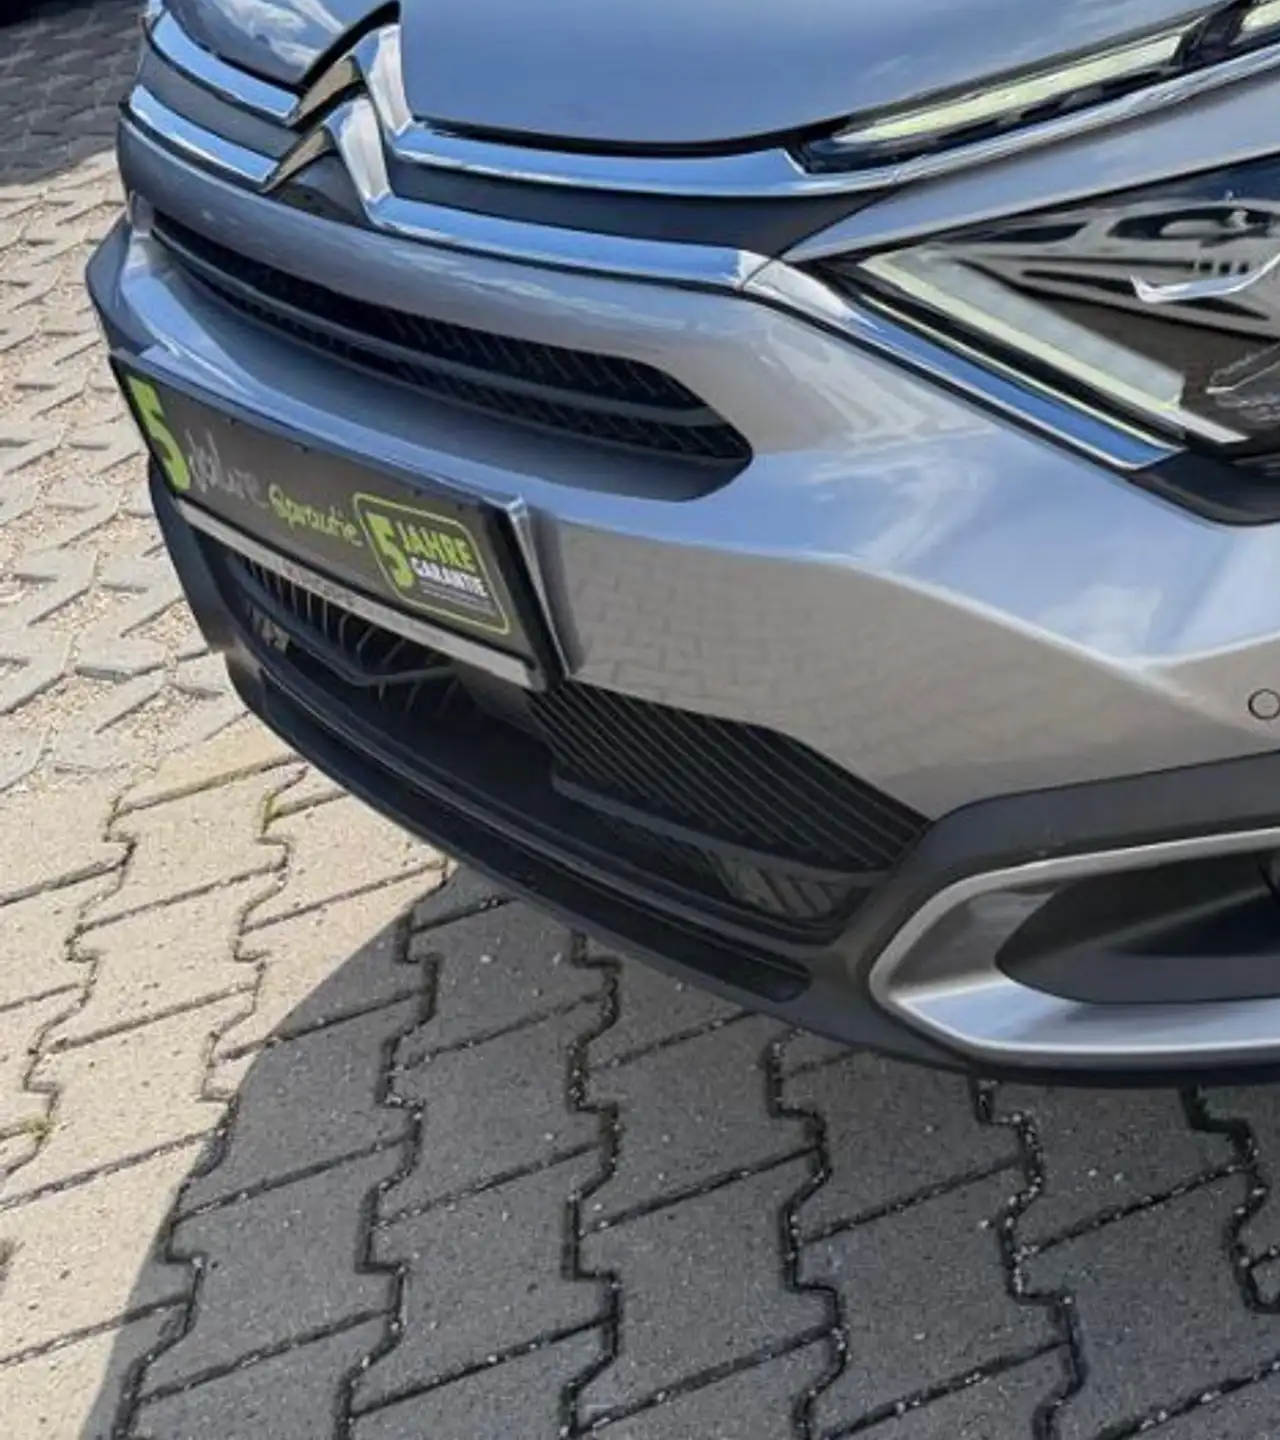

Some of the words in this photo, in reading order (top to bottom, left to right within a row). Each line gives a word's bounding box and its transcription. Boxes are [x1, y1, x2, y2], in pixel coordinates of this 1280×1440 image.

[127, 374, 191, 492] 5
[365, 511, 414, 588] 5
[396, 520, 477, 573] JAHRE
